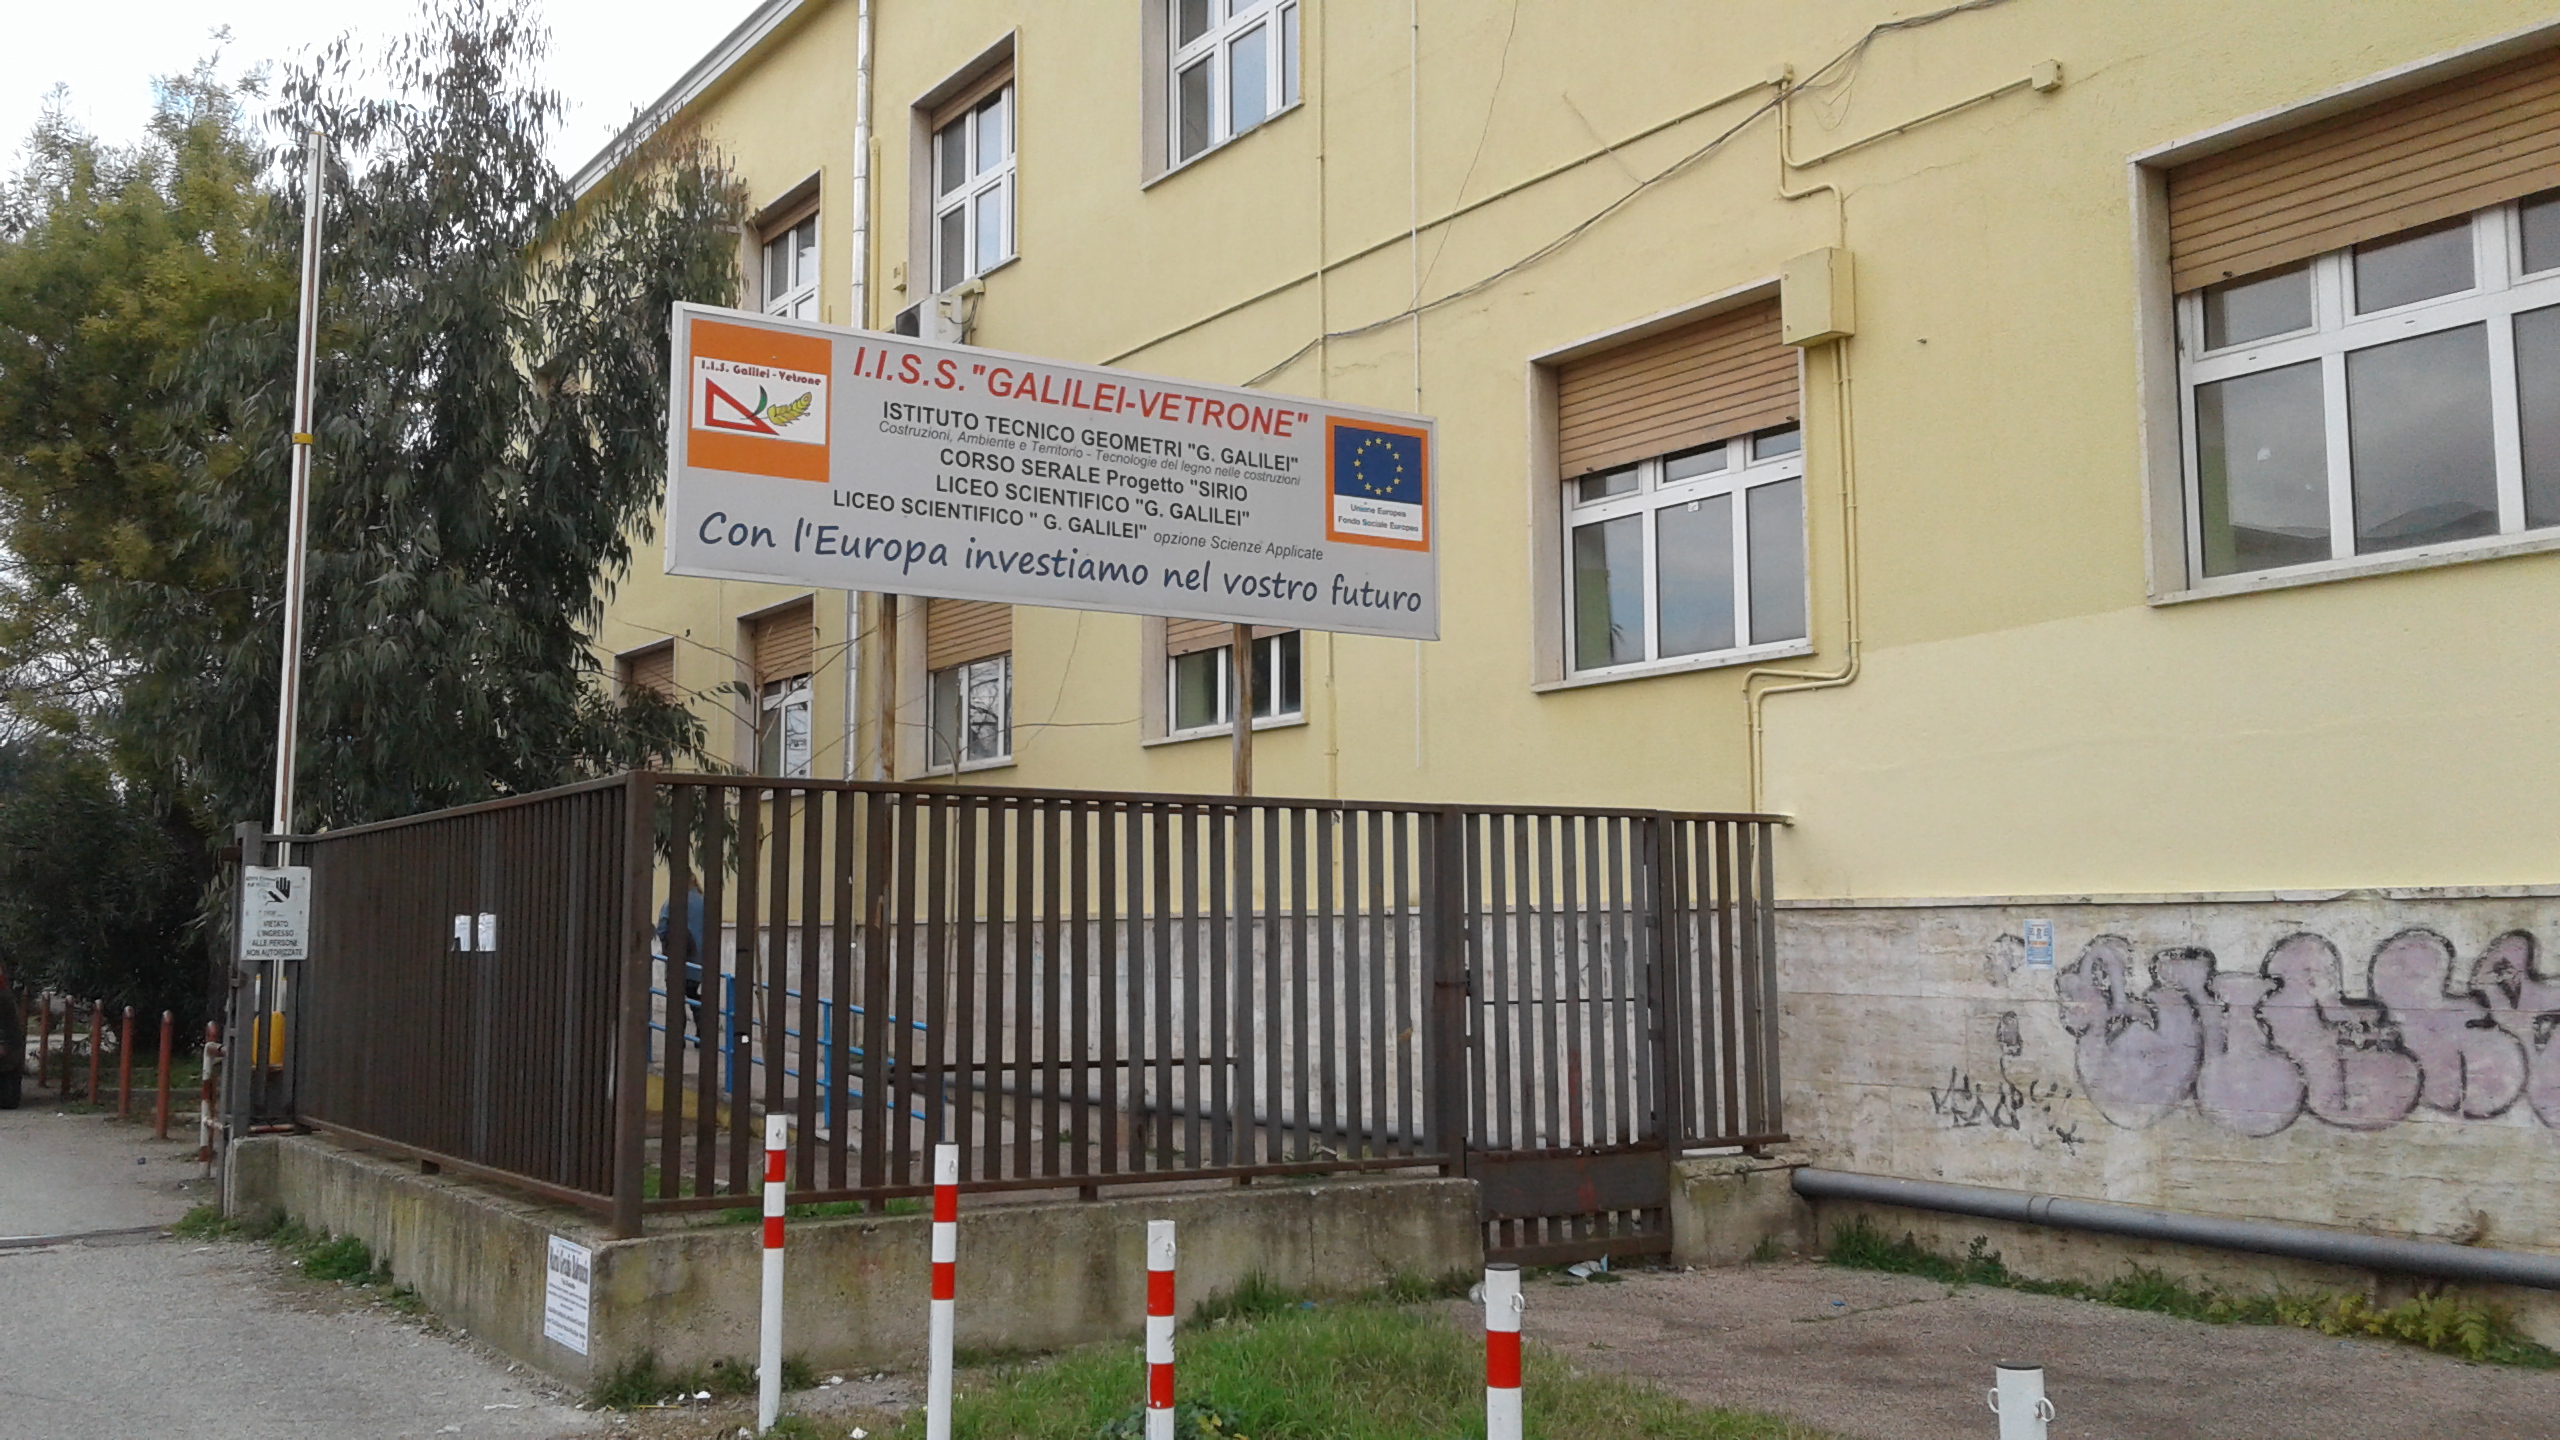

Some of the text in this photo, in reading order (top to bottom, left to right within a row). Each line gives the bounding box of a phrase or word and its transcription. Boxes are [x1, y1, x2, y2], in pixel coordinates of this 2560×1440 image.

[701, 359, 729, 373] I.I.S.
[733, 364, 770, 379] Galilei
[778, 370, 821, 386] Vetrone
[879, 420, 953, 443] Costruzioni,
[957, 431, 1015, 450] Ambiente
[1019, 440, 1027, 451] e
[1031, 440, 1083, 459] Territorio
[1095, 449, 1157, 470] Tecnologie
[1160, 457, 1178, 471] del
[1181, 460, 1212, 477] legno
[1214, 466, 1241, 479] nelle
[1243, 471, 1301, 486] costruzioni
[883, 401, 979, 430] ISTITUTO
[985, 415, 1075, 444] TECNICO
[1081, 429, 1182, 458] GEOMETRI
[1220, 447, 1299, 473] GALILEI"
[940, 448, 1248, 501] CORSO SERALE Progetto "SIRIO
[936, 474, 999, 498] LICEO
[1005, 483, 1130, 513] SCIENTIFICO
[1169, 503, 1250, 527] GALILEI"
[1350, 503, 1407, 518] Unione Europea
[833, 489, 895, 512] LICEO
[901, 497, 1024, 527] SCIENTIFICO
[1068, 516, 1147, 540] GALILEI"
[1153, 532, 1207, 549] opzione
[1210, 535, 1262, 555] Scienze
[1265, 541, 1324, 562] Applicate
[1338, 515, 1419, 532] Fondo Sociale Europea
[699, 511, 1423, 611] Con l'Europa investiamo nel vostro futuro
[251, 939, 298, 947] ALLE PERSONE
[263, 920, 289, 928] VIETATO
[246, 948, 303, 957] NON AUTORIZZATE
